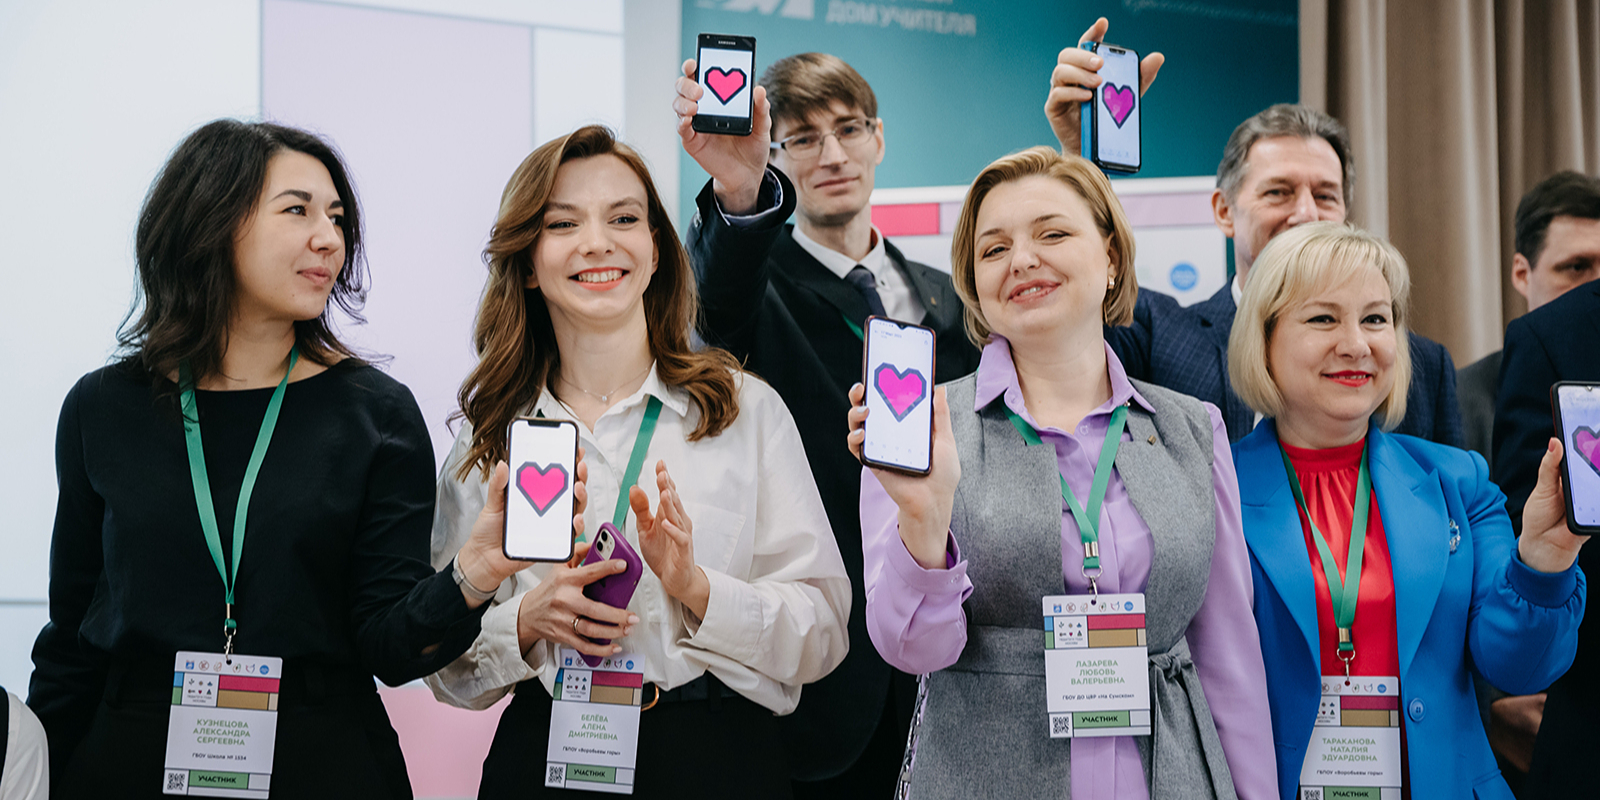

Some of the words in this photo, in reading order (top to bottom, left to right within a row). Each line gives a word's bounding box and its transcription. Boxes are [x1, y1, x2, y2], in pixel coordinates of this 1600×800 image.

[1076, 660, 1118, 668] ЛАЗАРЕВА
[1079, 668, 1115, 676] ЛЮБОВЬ
[1070, 677, 1125, 685] ВАЛЕРЬЕВНА
[581, 713, 608, 723] БЕЛЁВА
[197, 719, 249, 729] КУЗНЕЦОВА
[581, 723, 606, 731] АЛЕНА
[193, 728, 251, 737] АЛЕКСАНДРА
[568, 730, 618, 741] ДМИТРИЕВНА
[197, 736, 245, 746] СЕРГЕЕВНА
[1322, 754, 1378, 762] ЭДУАРДОВНА
[574, 769, 606, 777] УЧАСТНИК
[198, 775, 237, 784] УЧАСТНИК
[1333, 790, 1369, 798] УЧАСТНИК
